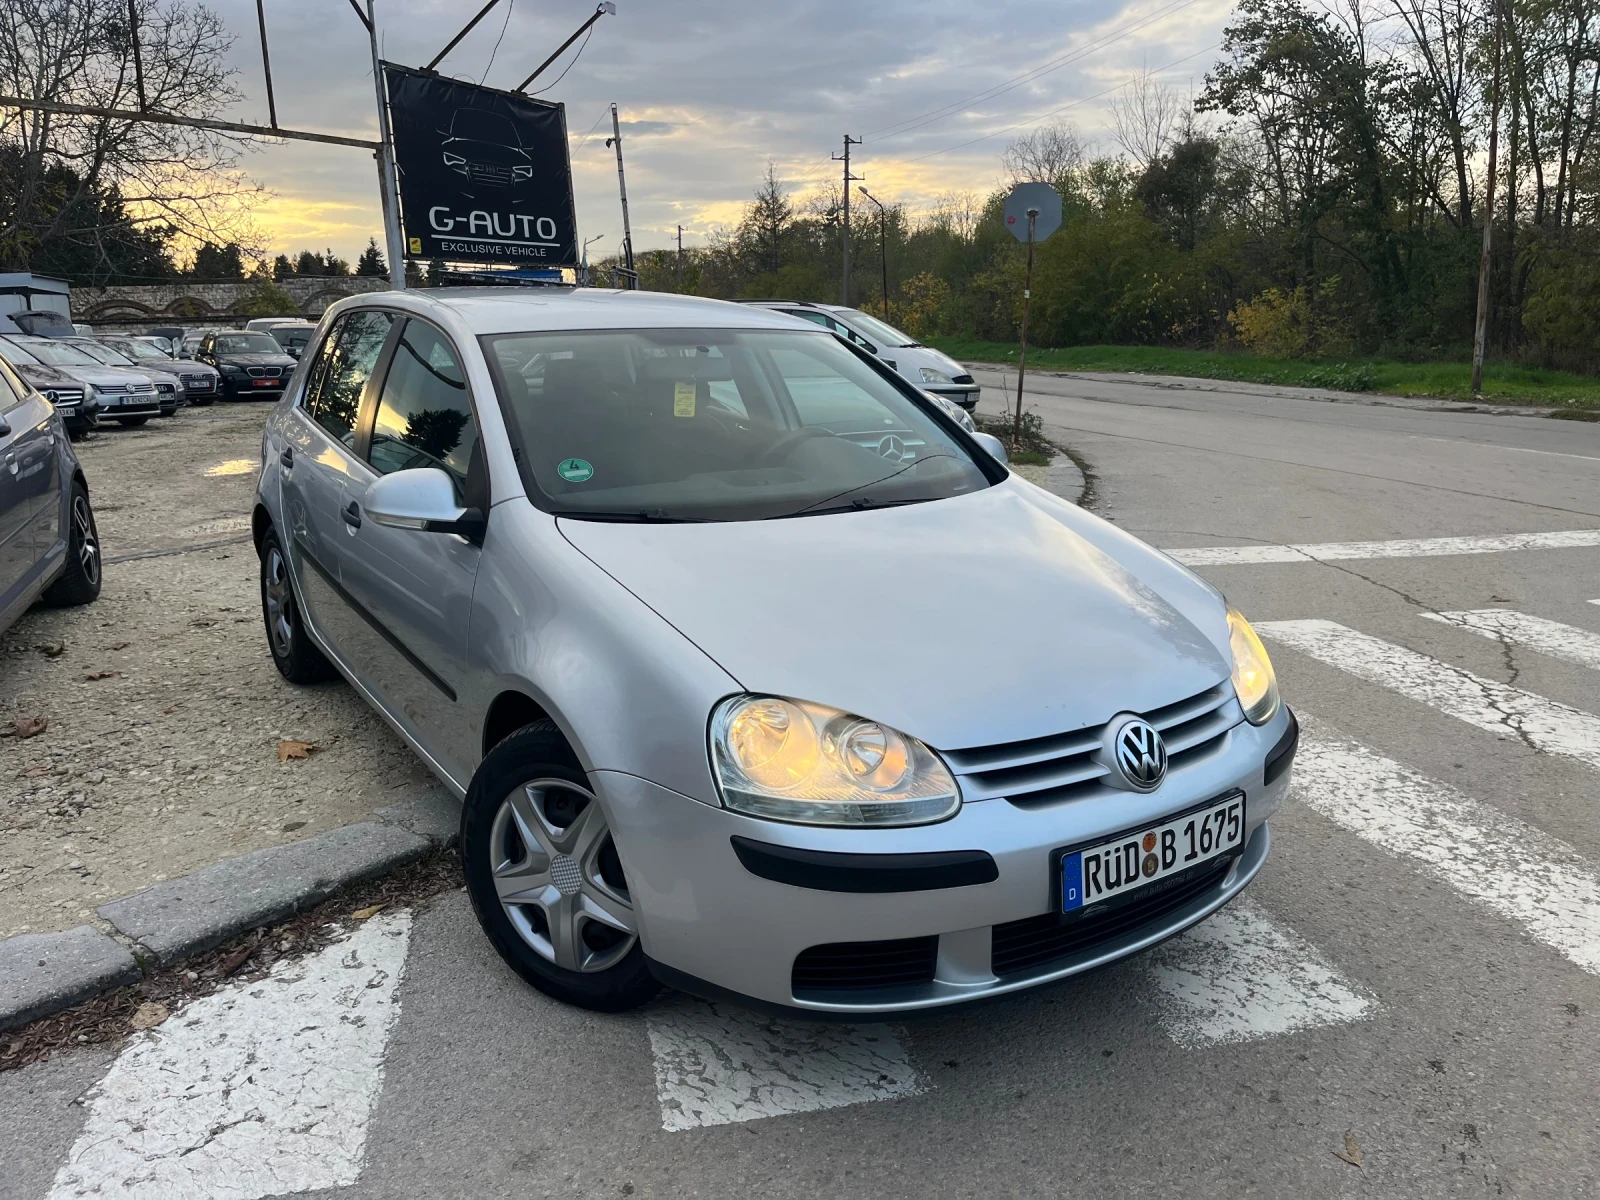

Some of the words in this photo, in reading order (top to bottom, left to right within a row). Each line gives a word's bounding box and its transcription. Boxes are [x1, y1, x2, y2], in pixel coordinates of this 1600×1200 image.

[429, 206, 557, 240] G-AUTO
[441, 241, 503, 255] EXCLUSIVE
[505, 246, 547, 257] VEHICLE
[570, 460, 580, 470] 4
[1084, 841, 1140, 899] RÜD
[1161, 828, 1177, 871] B
[1184, 802, 1240, 862] 1675
[1069, 888, 1076, 900] D
